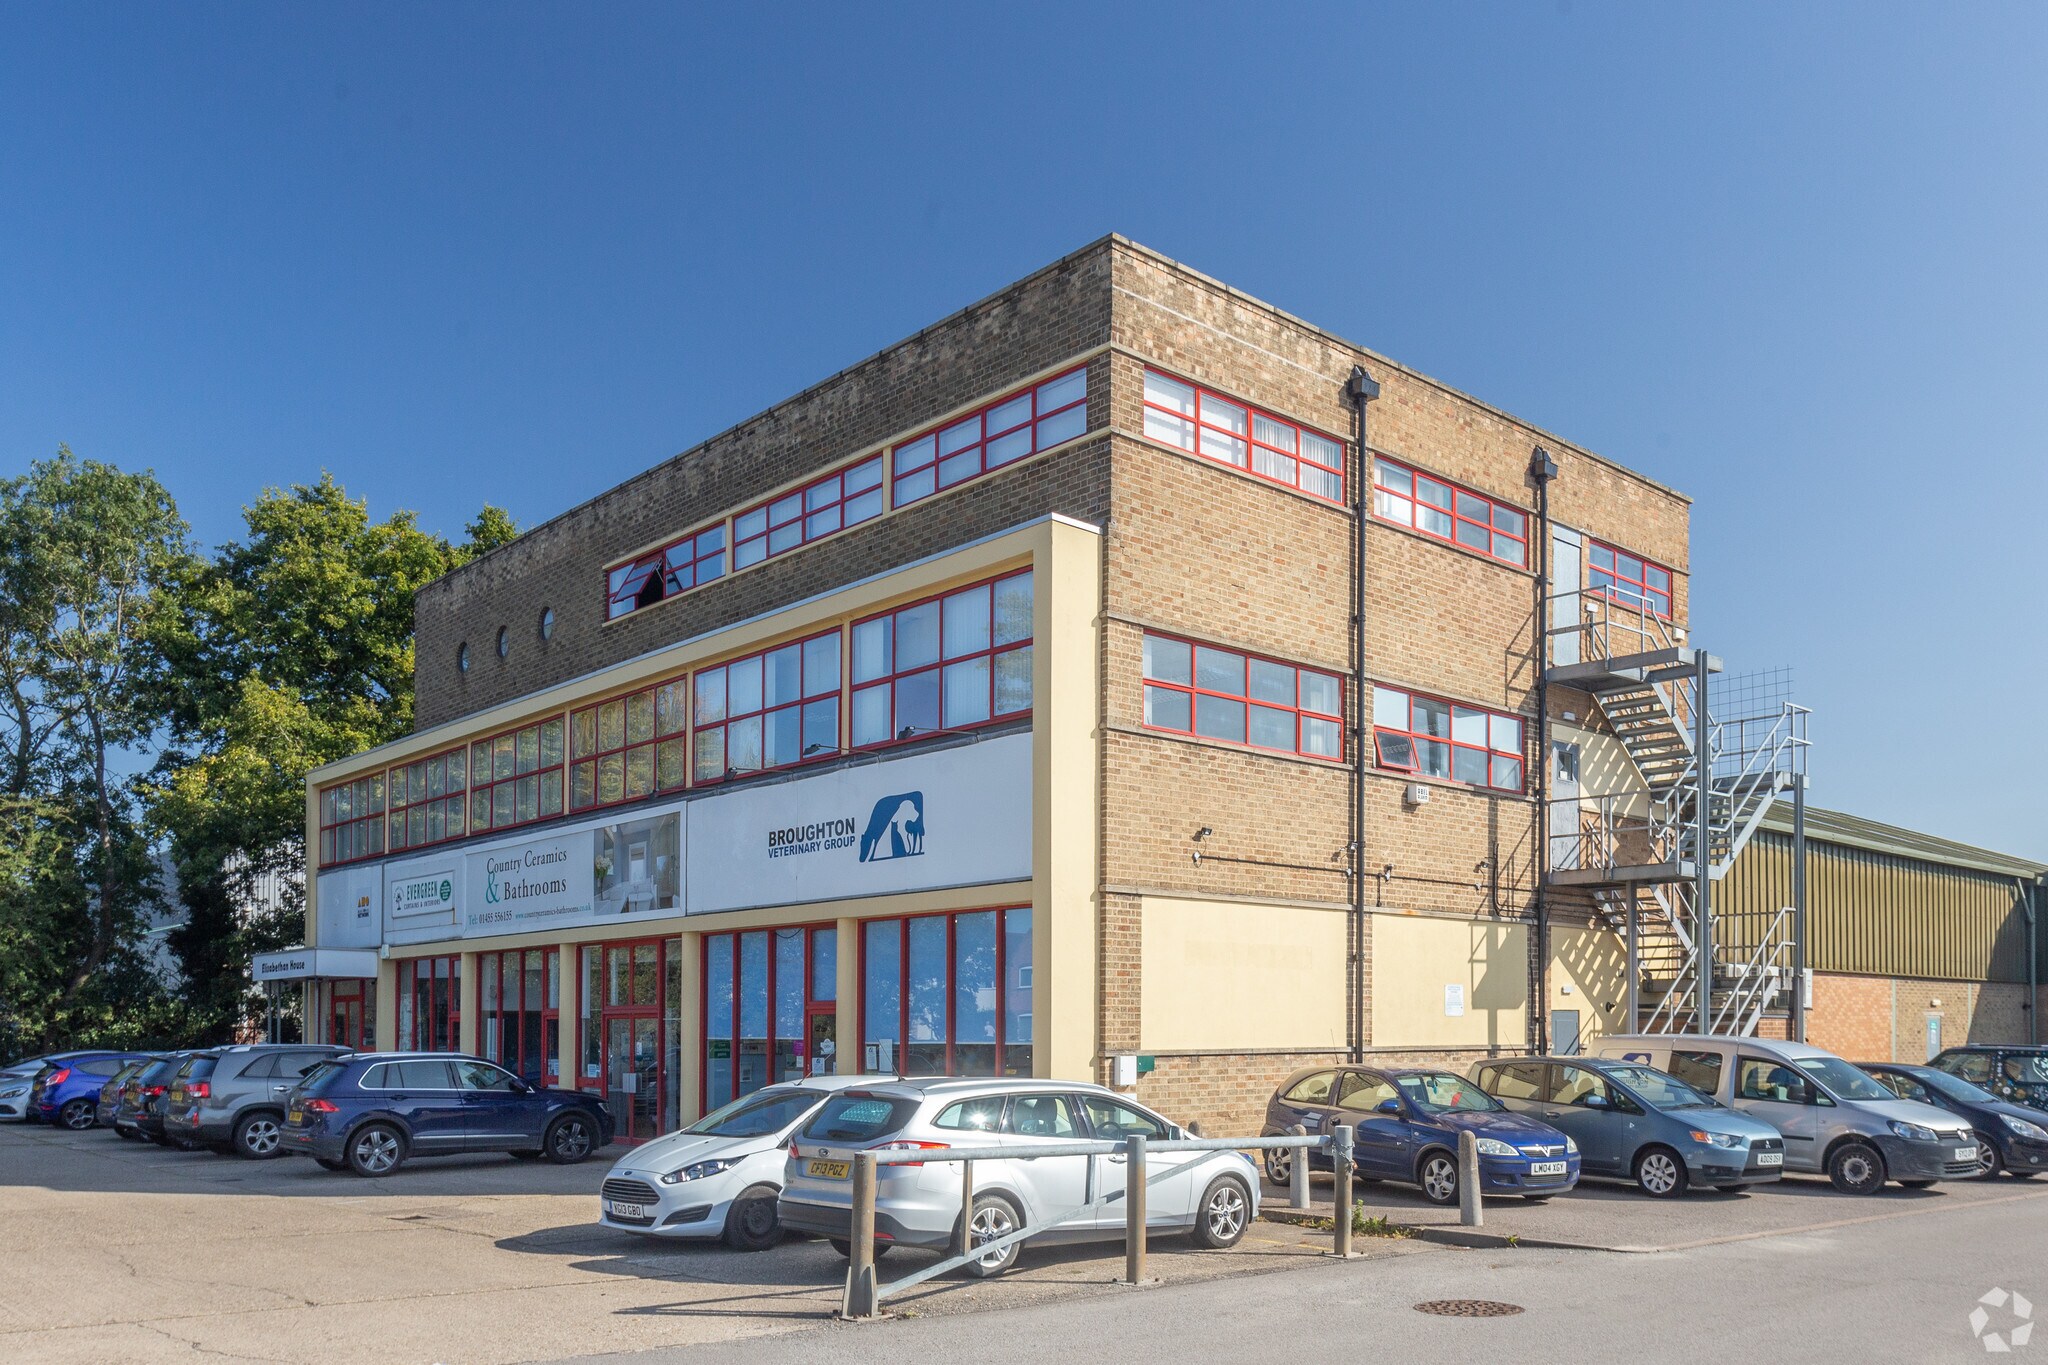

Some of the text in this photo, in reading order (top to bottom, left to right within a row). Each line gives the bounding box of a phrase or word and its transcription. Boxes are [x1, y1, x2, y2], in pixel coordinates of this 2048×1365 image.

[768, 817, 855, 847] BROUGHTON
[768, 836, 856, 858] VETERINARY GROUP
[487, 847, 567, 874] Country Ceramics
[406, 880, 438, 901] EVERGREEN
[485, 871, 567, 904] & Bathrooms
[478, 912, 494, 924] 01455
[289, 960, 305, 971] House
[810, 1162, 845, 1176] CF13 PGZ
